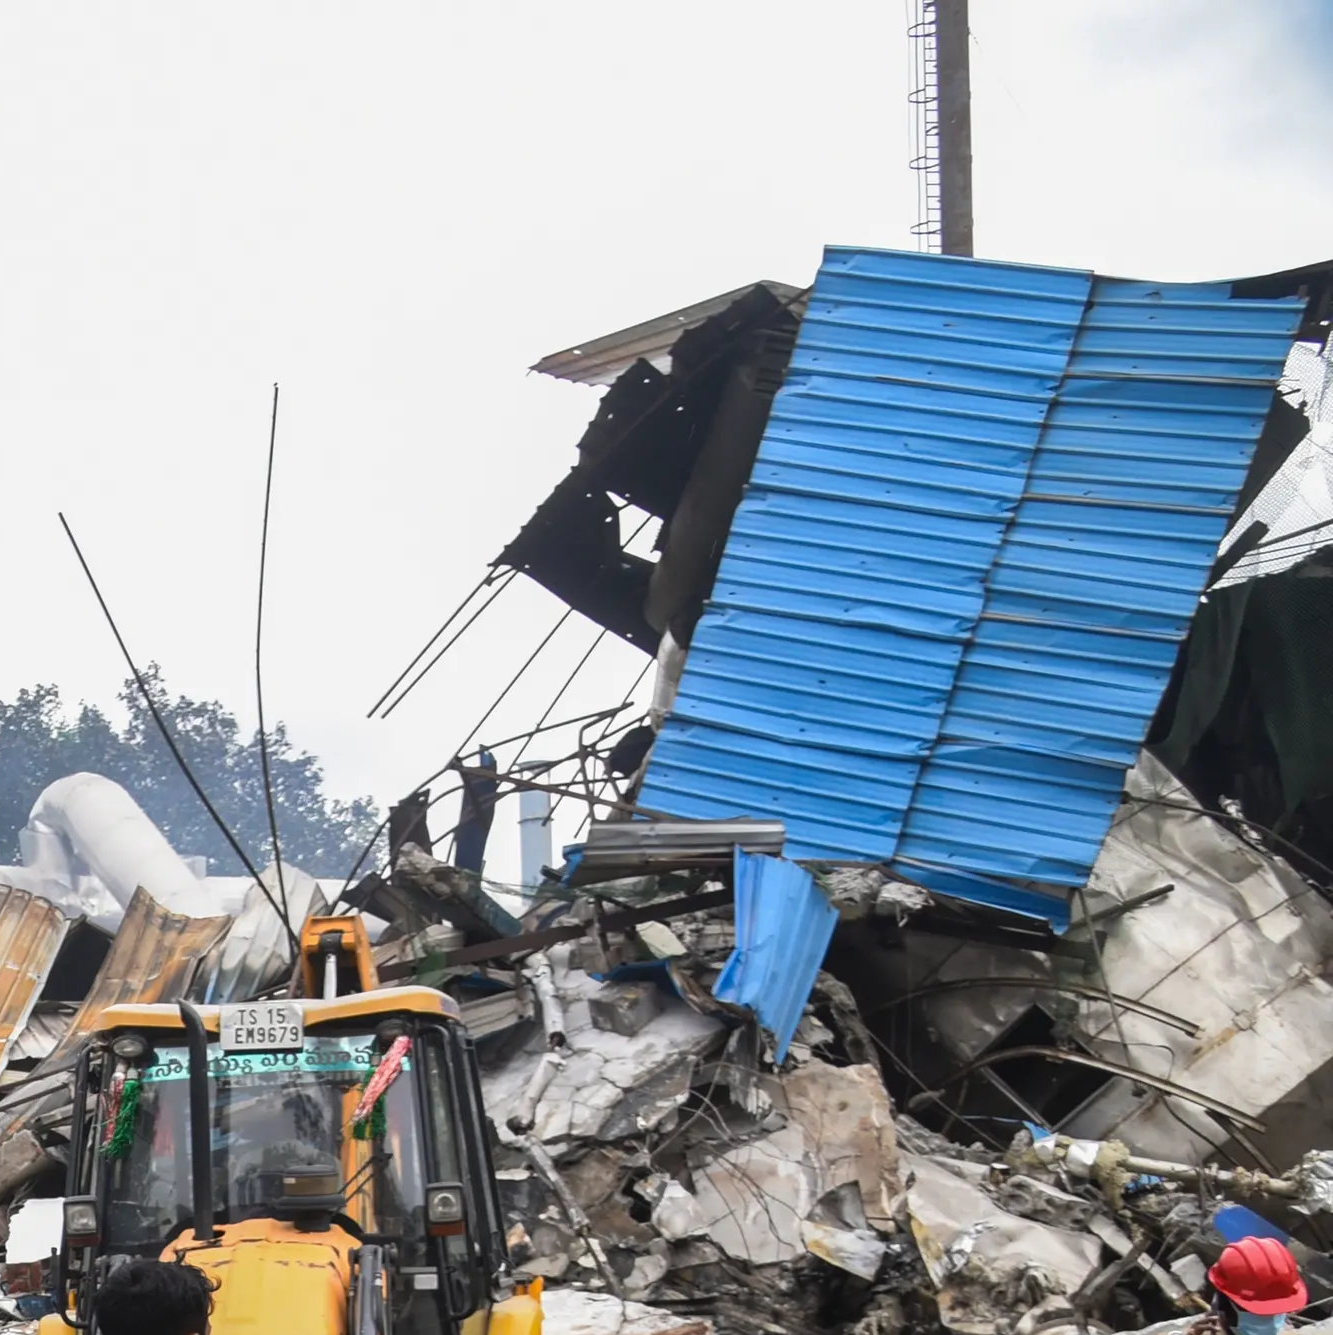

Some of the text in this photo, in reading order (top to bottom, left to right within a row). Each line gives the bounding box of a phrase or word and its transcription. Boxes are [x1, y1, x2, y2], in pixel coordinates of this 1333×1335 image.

[238, 1007, 286, 1025] TS 15
[234, 1026, 299, 1044] EM9679
